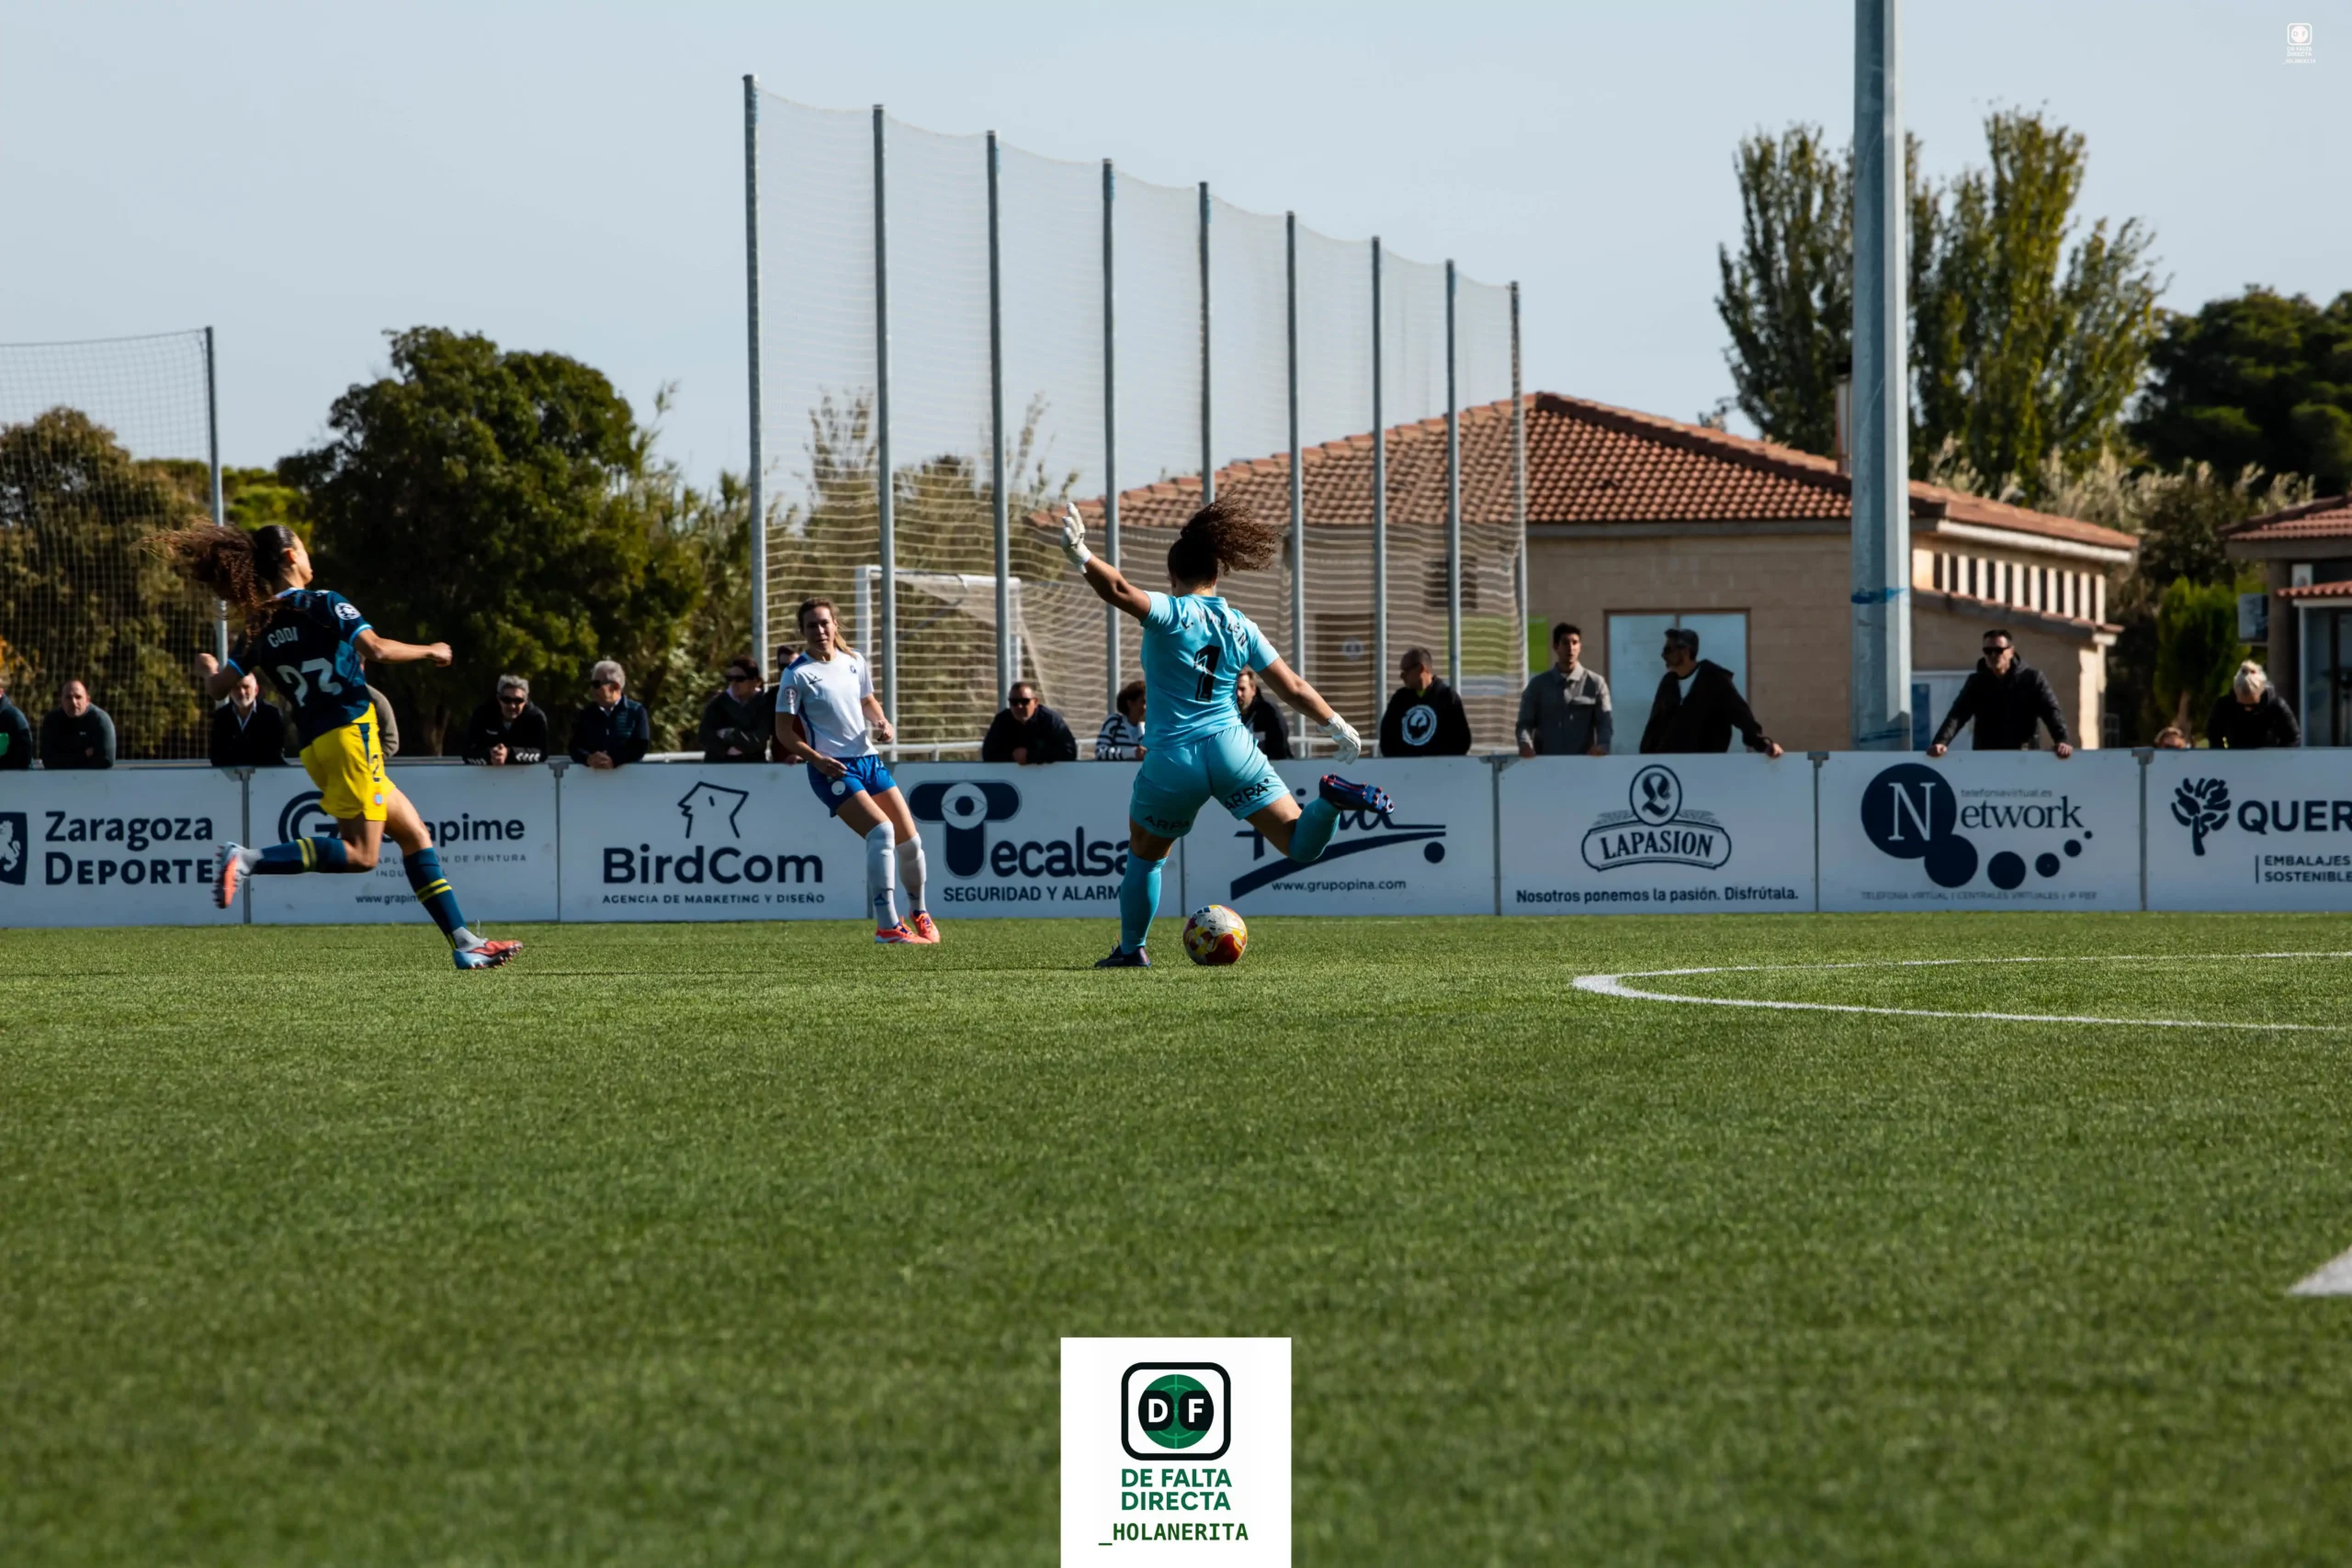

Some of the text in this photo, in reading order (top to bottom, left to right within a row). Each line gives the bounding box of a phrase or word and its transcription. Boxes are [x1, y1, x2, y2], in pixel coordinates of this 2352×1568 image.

[1193, 644, 1221, 704] 1
[46, 811, 213, 852] Zaragoza
[1600, 830, 1714, 860] LAPASION
[454, 854, 469, 863] DE
[474, 853, 526, 863] PINTURA
[603, 843, 823, 884] BirdCom
[2264, 855, 2350, 866] EMBALAJES
[944, 885, 1121, 902] SEGURIDAD Y ALARM
[1272, 878, 1407, 893] www.grupopina.com
[602, 892, 825, 904] AGENCIA DE MARKETING Y DISEÑO
[1516, 886, 1798, 904] Nosotros ponemos la pasión. Disfrútala.
